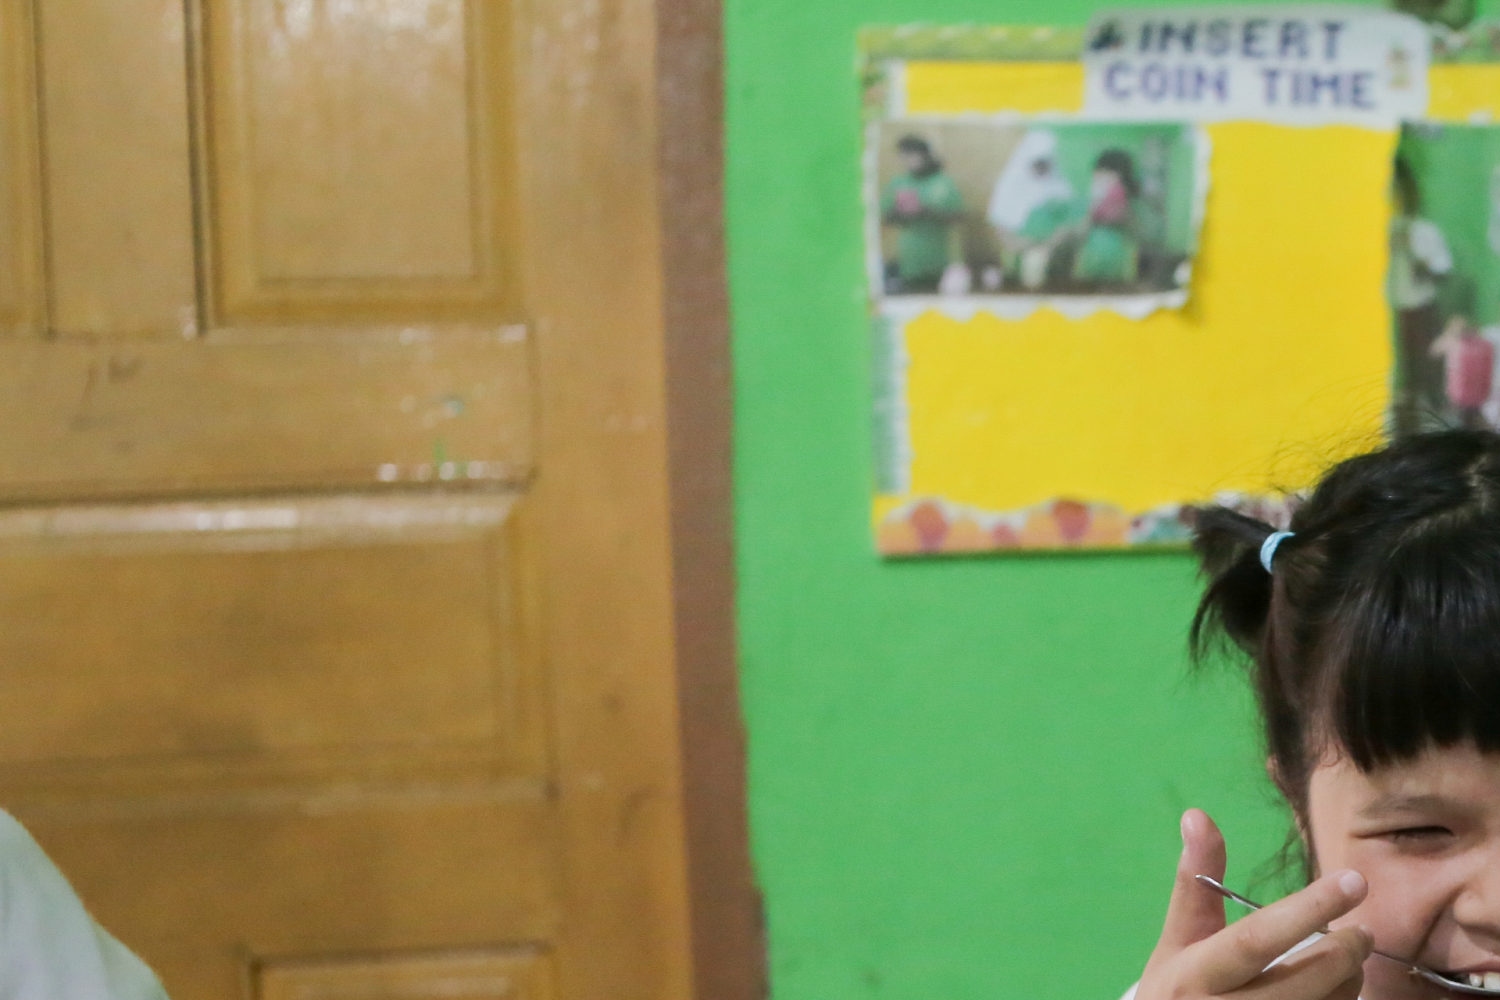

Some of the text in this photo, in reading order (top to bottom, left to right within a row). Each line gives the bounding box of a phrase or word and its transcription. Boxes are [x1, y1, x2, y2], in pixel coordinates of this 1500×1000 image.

[1138, 18, 1344, 61] INSERT
[1103, 61, 1377, 110] COIN TIME
